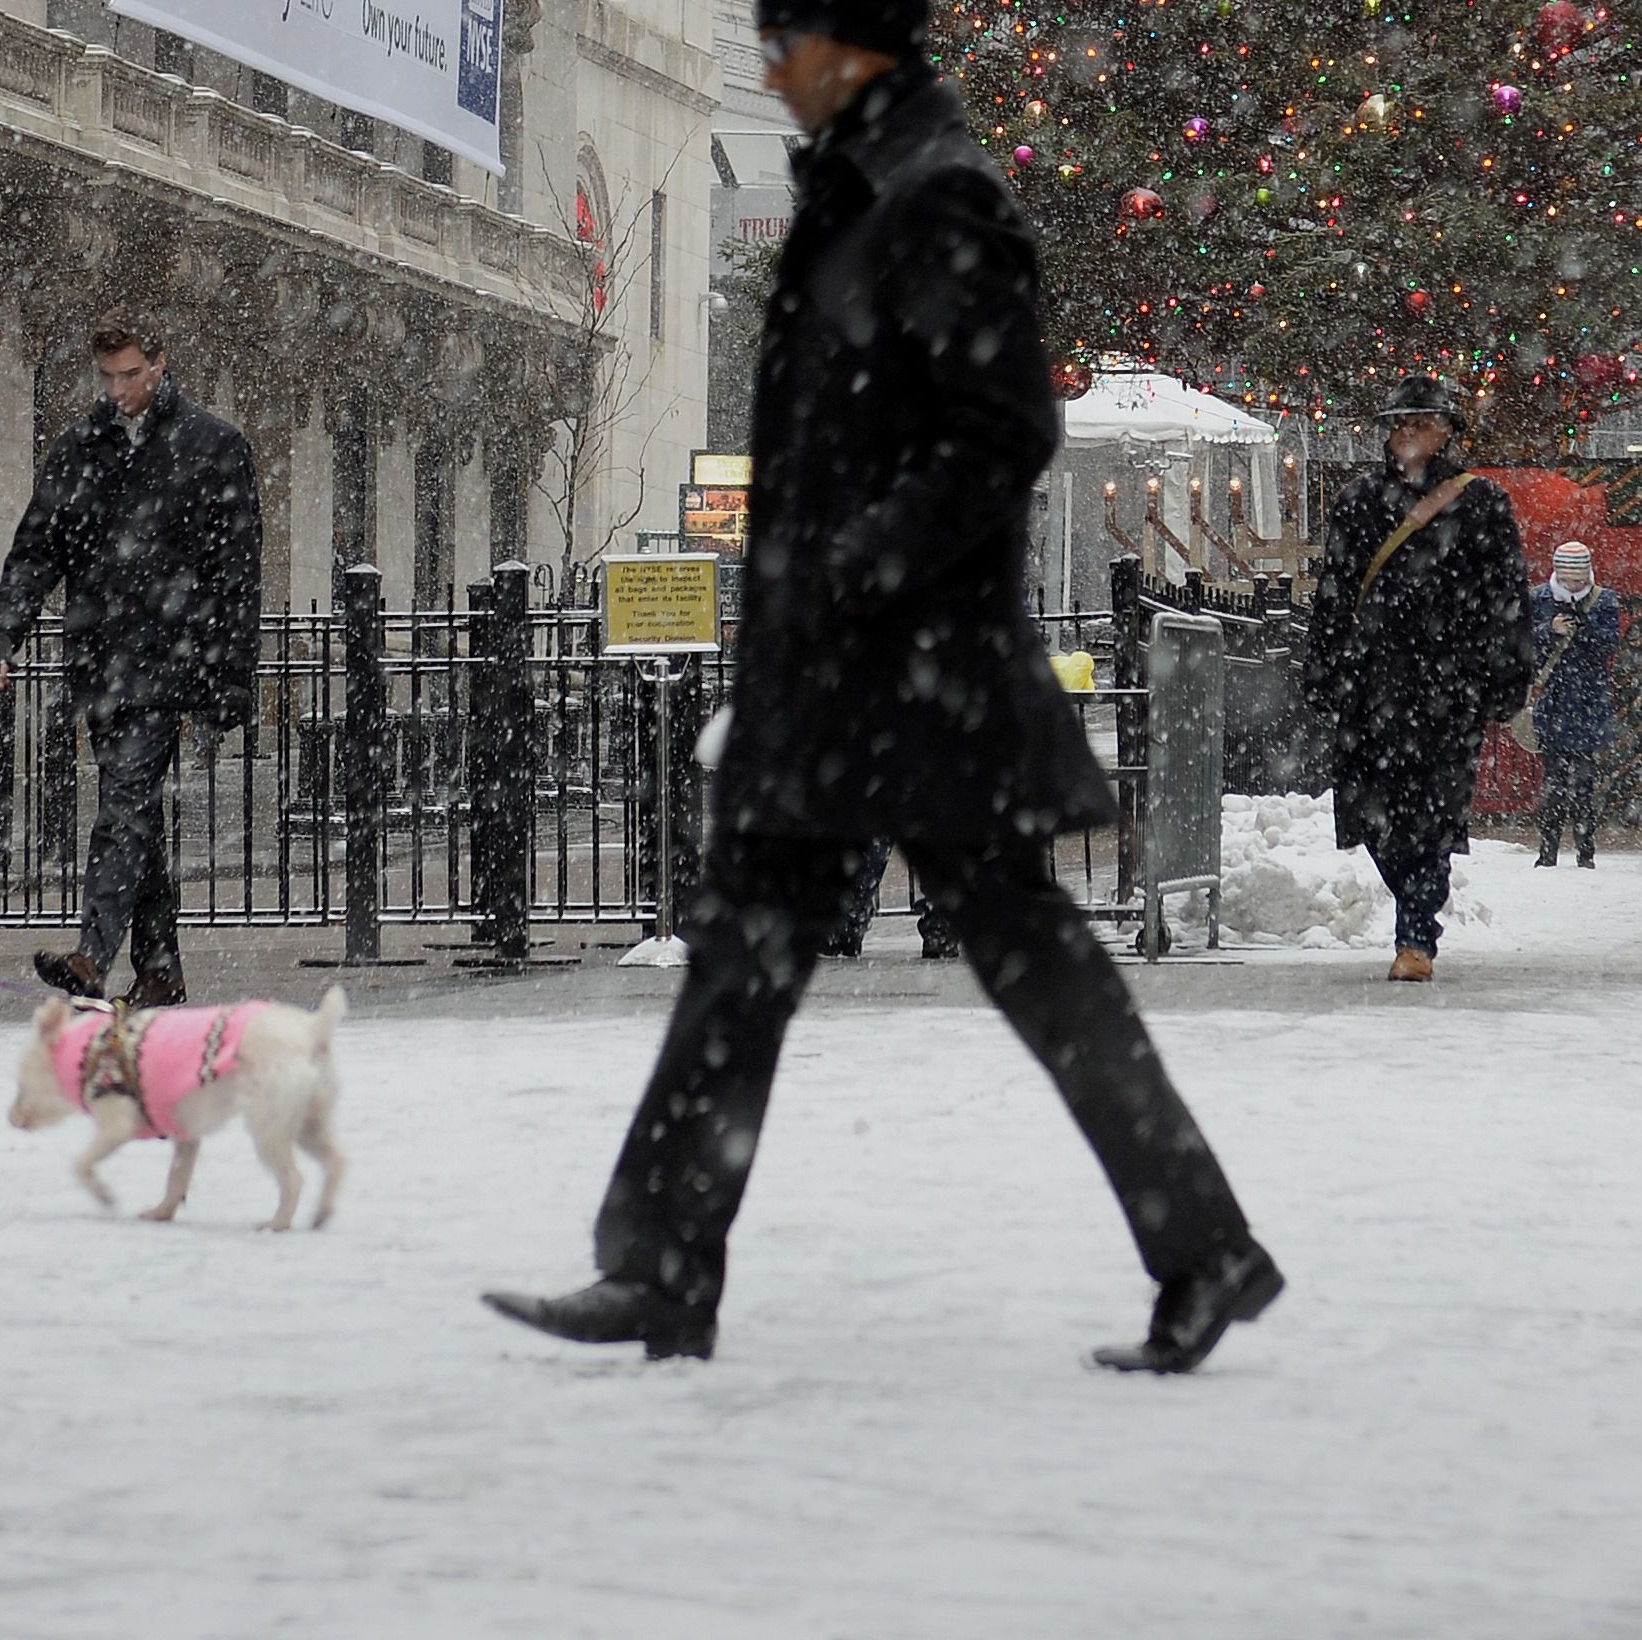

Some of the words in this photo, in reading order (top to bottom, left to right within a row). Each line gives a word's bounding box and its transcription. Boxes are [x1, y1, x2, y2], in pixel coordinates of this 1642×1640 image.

[386, 16, 413, 57] your
[414, 15, 448, 72] future.
[466, 18, 493, 74] NYSE
[628, 586, 647, 594] bags
[628, 635, 661, 643] Security
